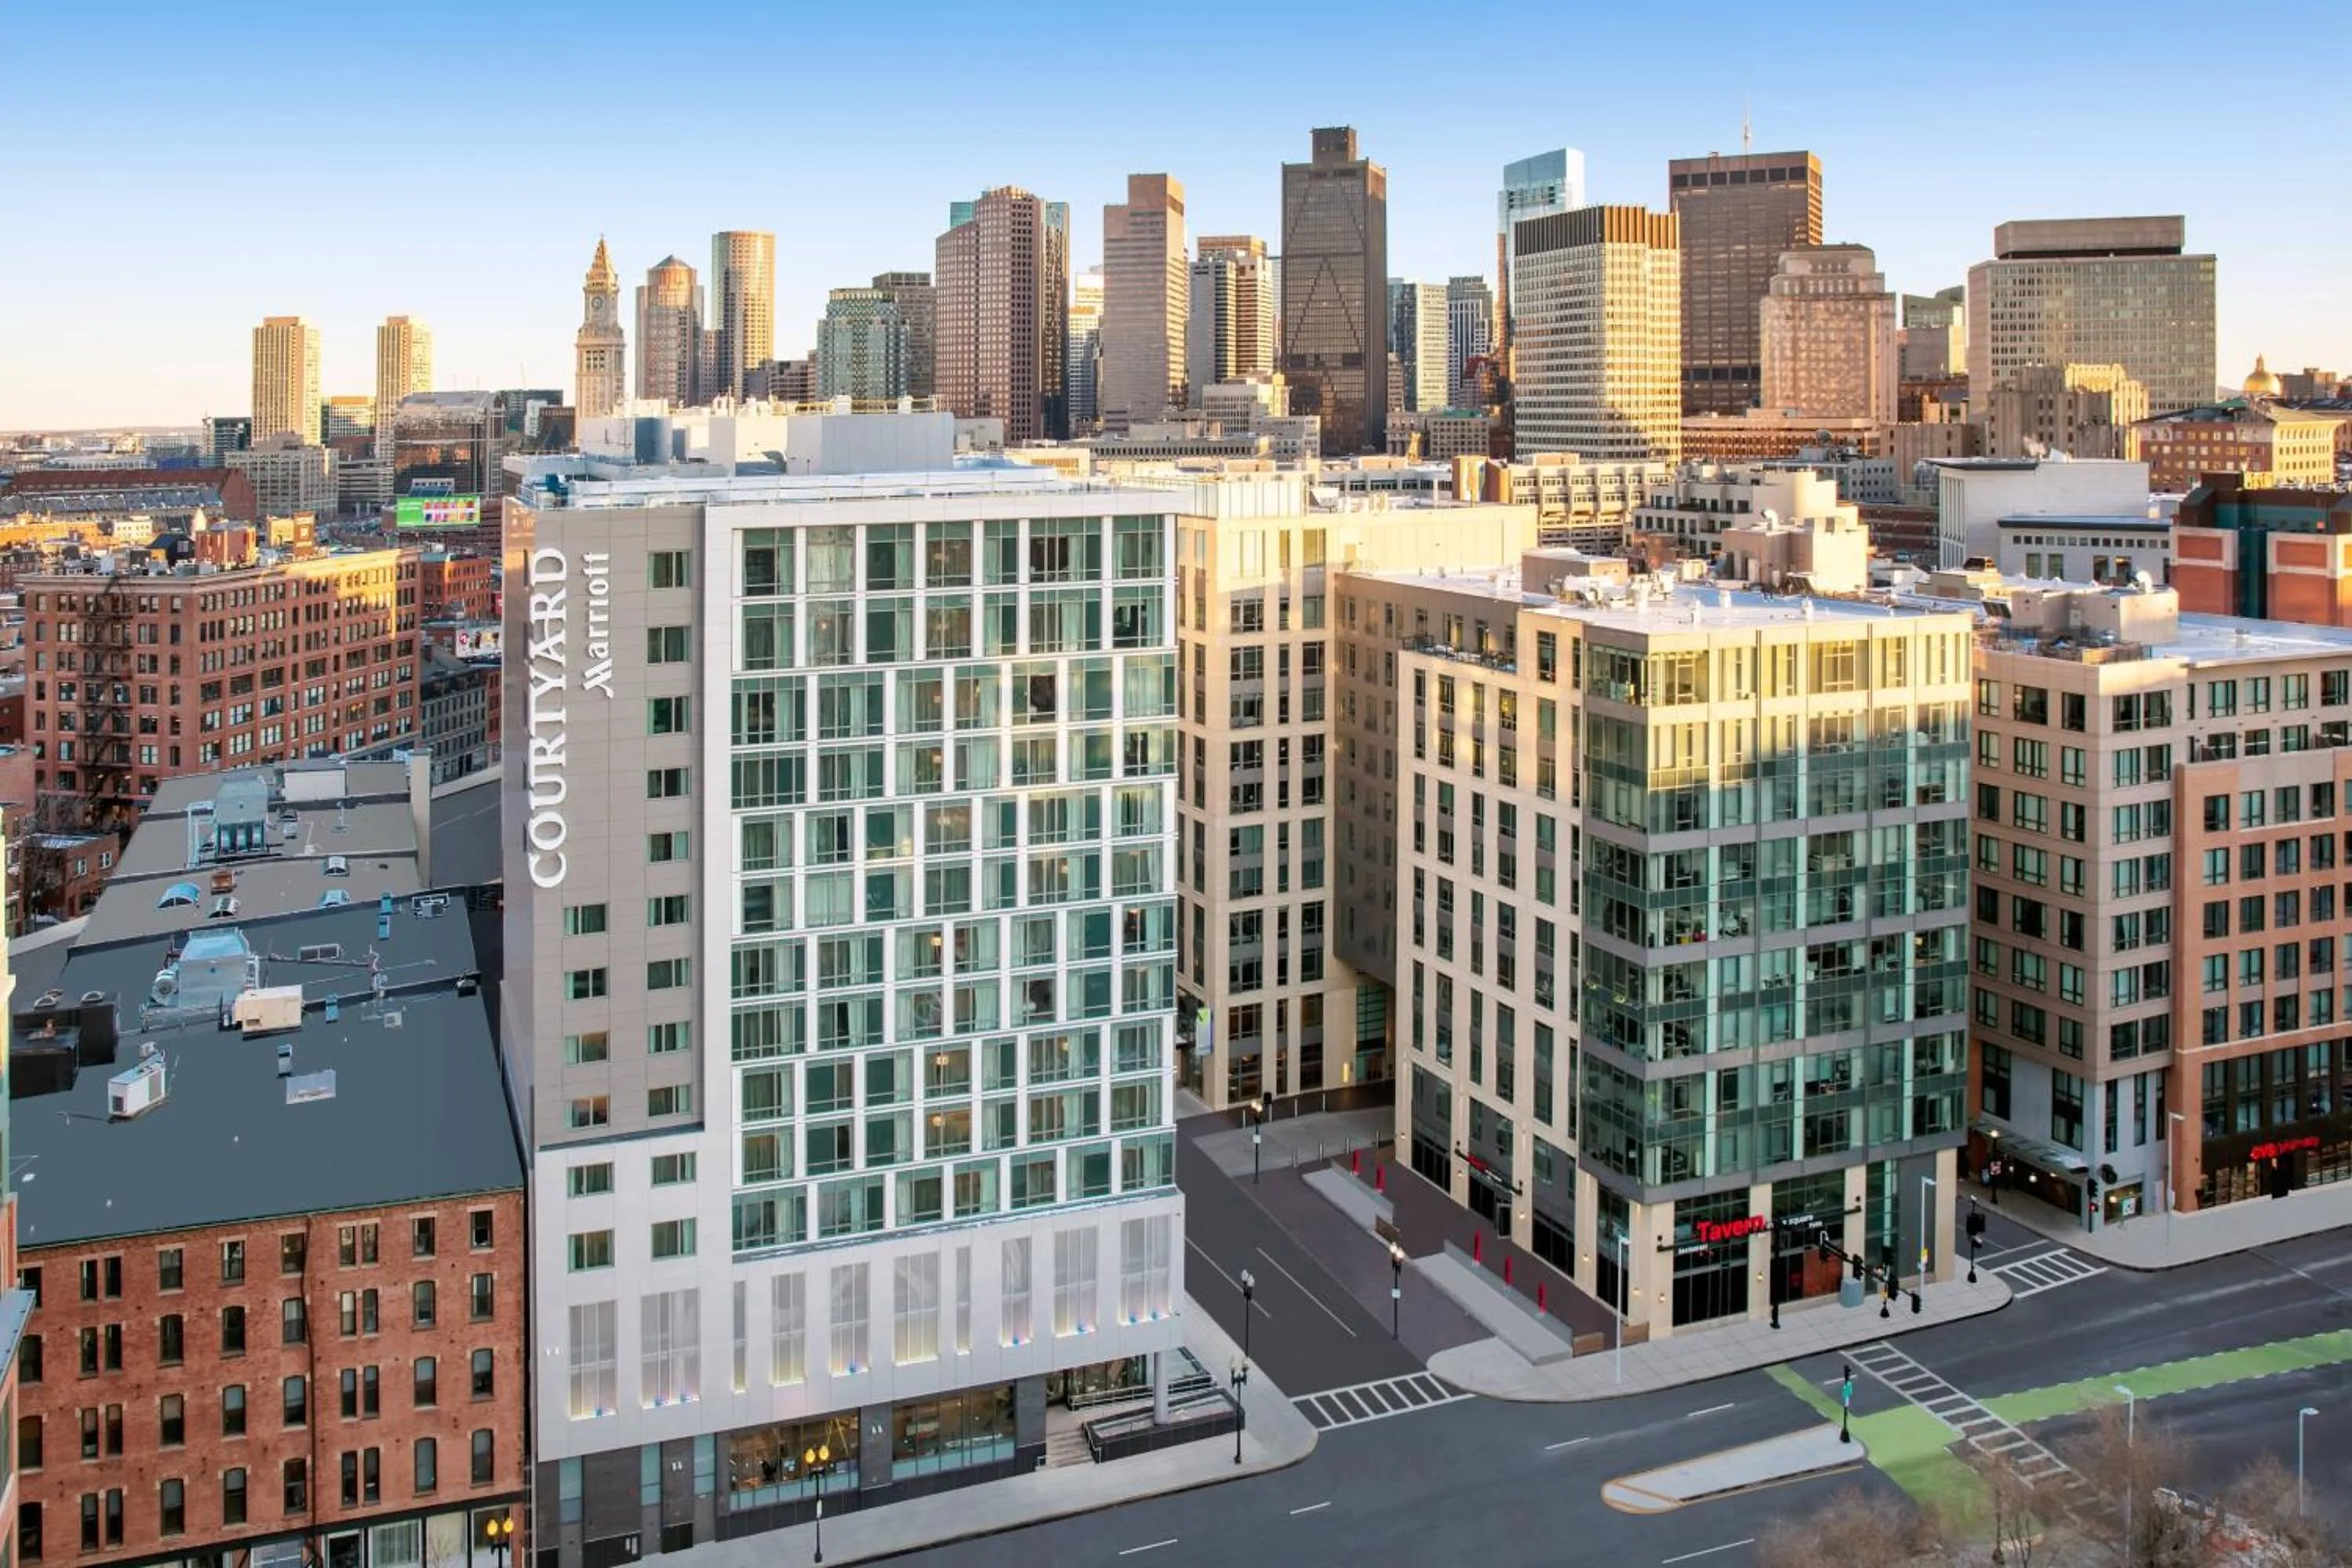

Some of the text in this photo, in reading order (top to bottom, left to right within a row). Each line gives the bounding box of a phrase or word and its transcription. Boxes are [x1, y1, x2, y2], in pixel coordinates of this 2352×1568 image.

[581, 551, 614, 699] Marriott
[528, 546, 568, 889] COURTYARD
[1696, 1213, 1766, 1243] Tavern
